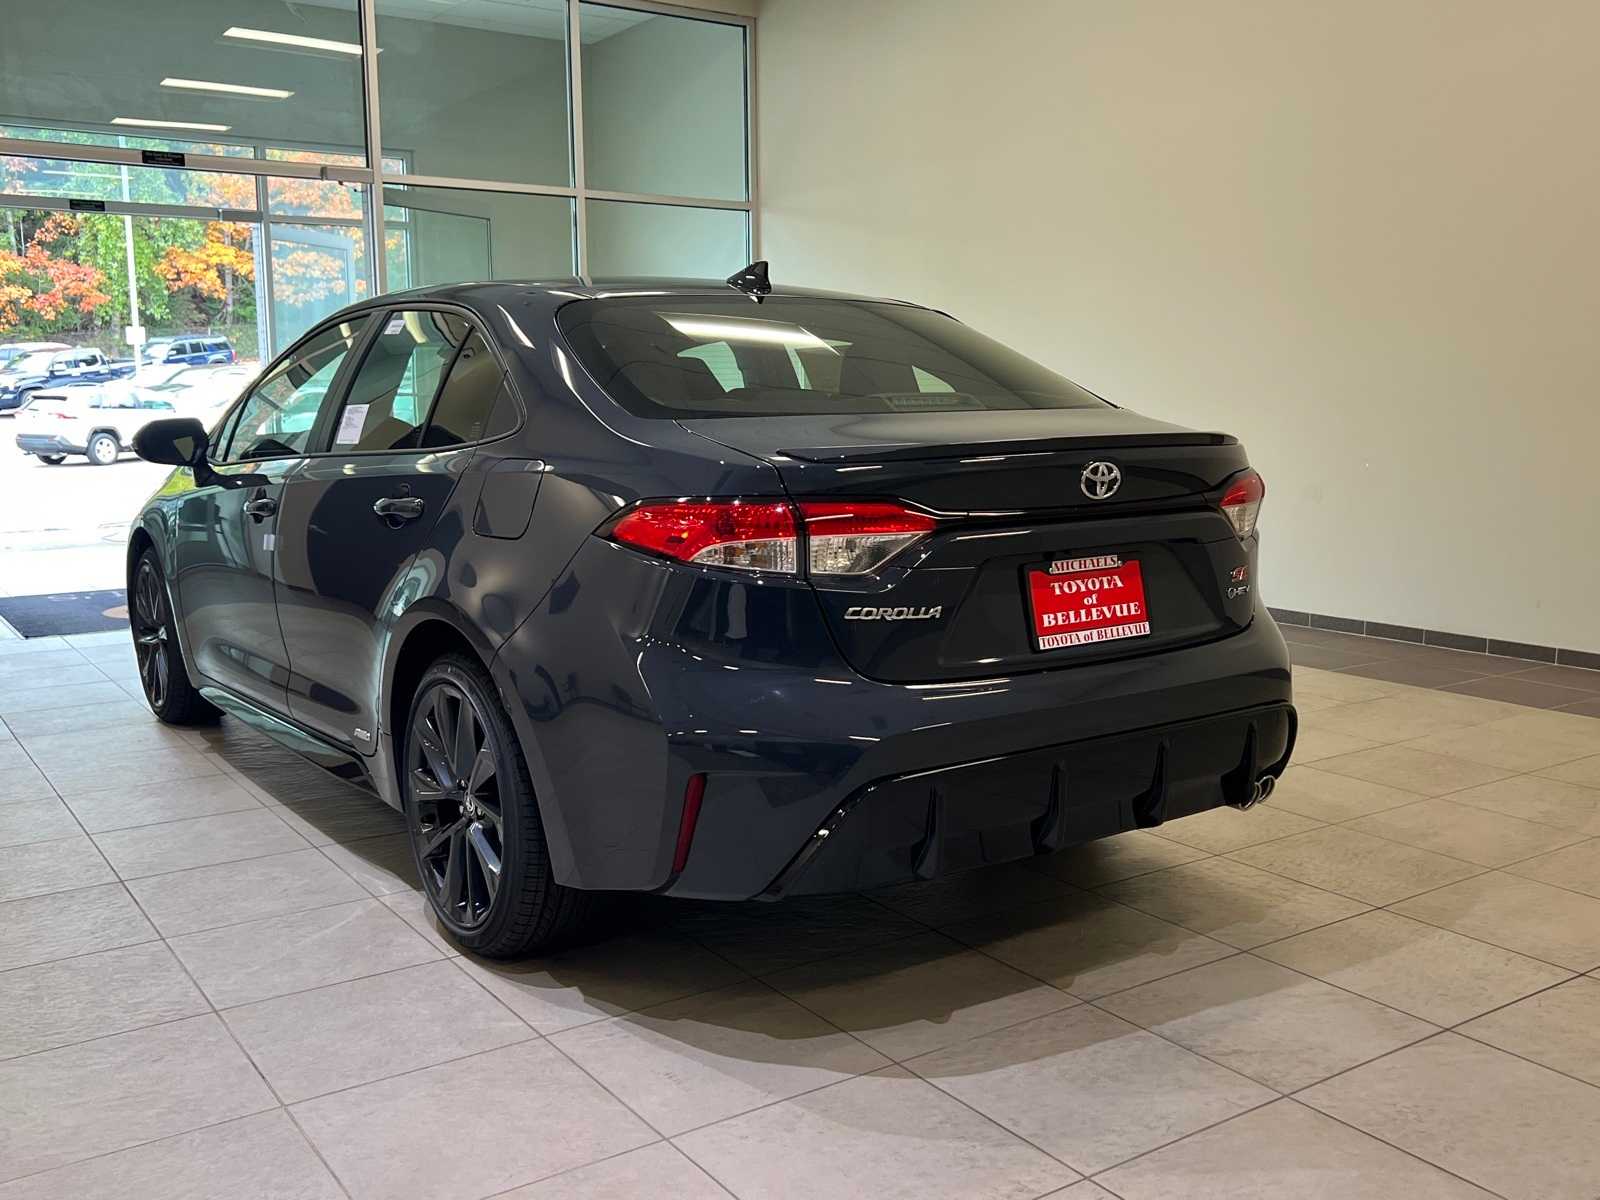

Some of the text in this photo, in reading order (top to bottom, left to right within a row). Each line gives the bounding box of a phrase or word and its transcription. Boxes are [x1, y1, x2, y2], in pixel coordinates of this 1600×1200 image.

[1052, 555, 1117, 573] MICHAELS
[1050, 575, 1124, 596] TOYOTA
[1083, 593, 1098, 606] of
[844, 605, 942, 621] COROLLA
[1041, 601, 1141, 628] BELLEVUE
[1040, 622, 1150, 649] TOYOTA of BELLEVUE
